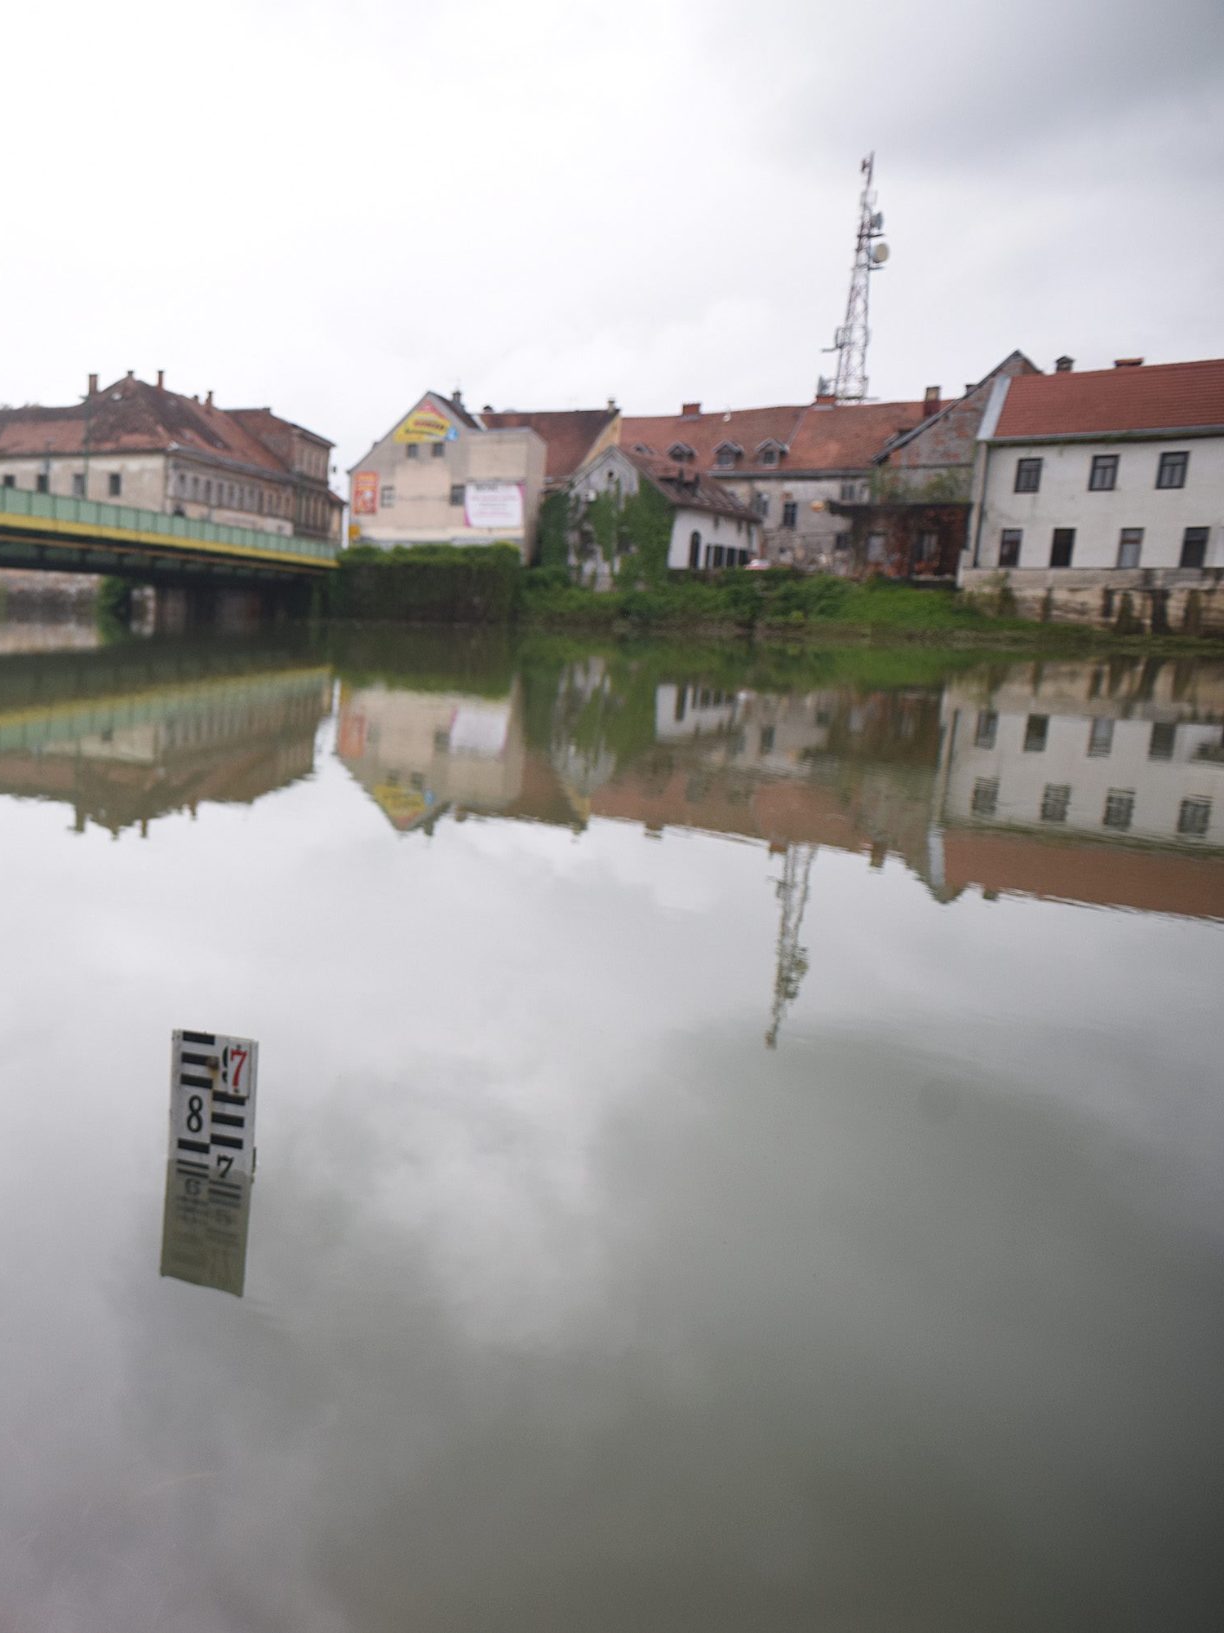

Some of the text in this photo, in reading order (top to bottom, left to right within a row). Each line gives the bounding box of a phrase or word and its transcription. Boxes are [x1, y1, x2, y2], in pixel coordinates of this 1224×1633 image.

[230, 1049, 248, 1088] 7
[186, 1095, 203, 1133] 8
[217, 1154, 234, 1178] 7
